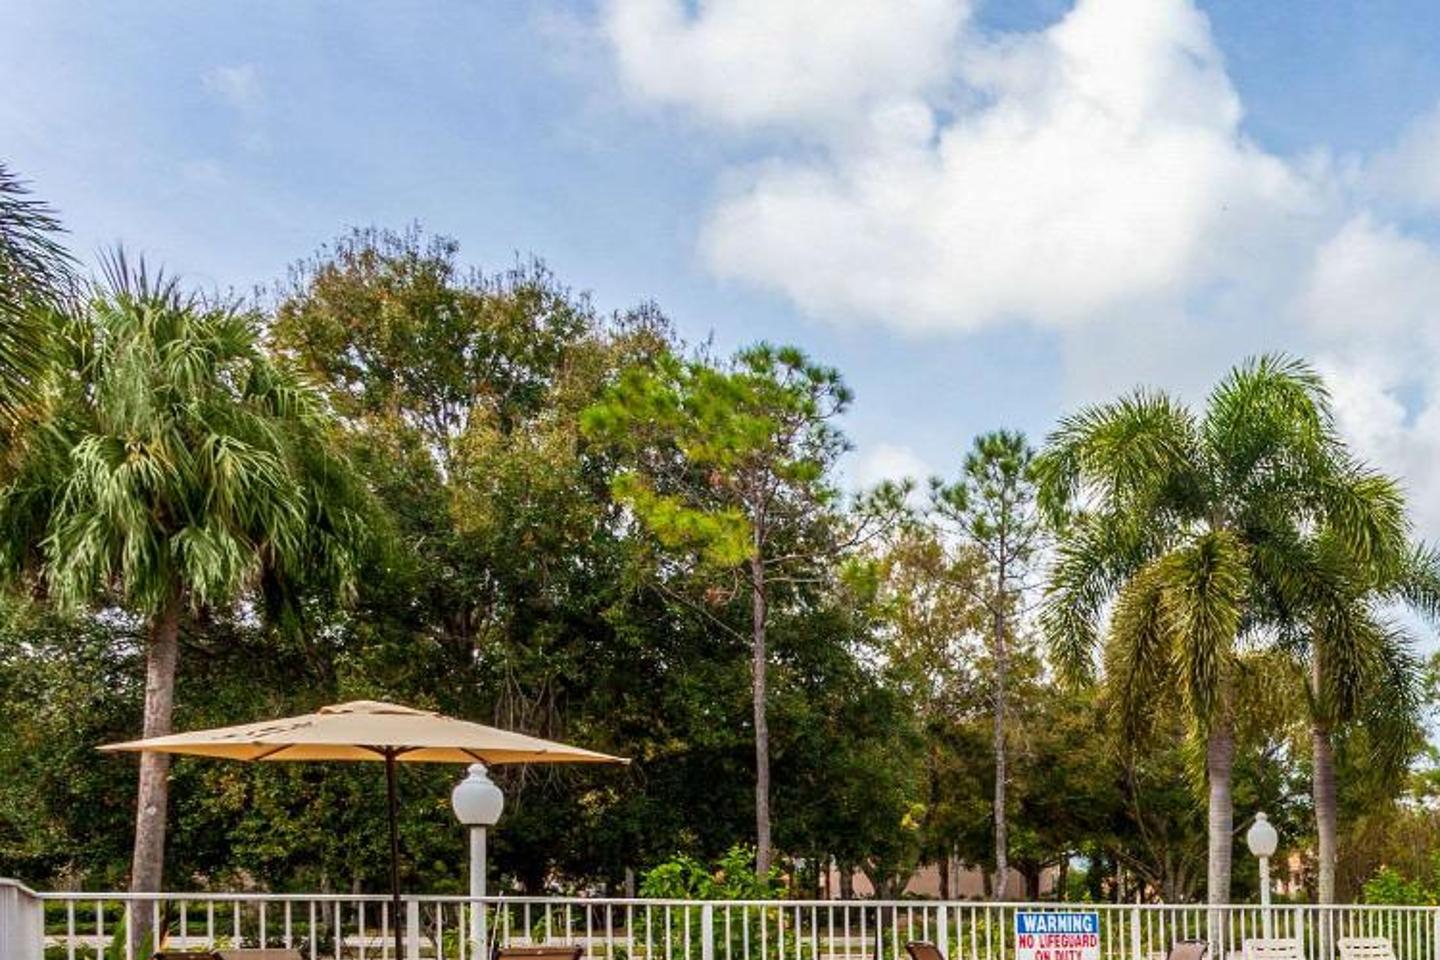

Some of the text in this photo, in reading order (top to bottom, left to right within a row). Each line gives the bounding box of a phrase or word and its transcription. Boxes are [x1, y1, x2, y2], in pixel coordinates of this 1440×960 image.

[1022, 914, 1094, 933] WARNING
[1019, 934, 1097, 949] NO LIFEGUARD
